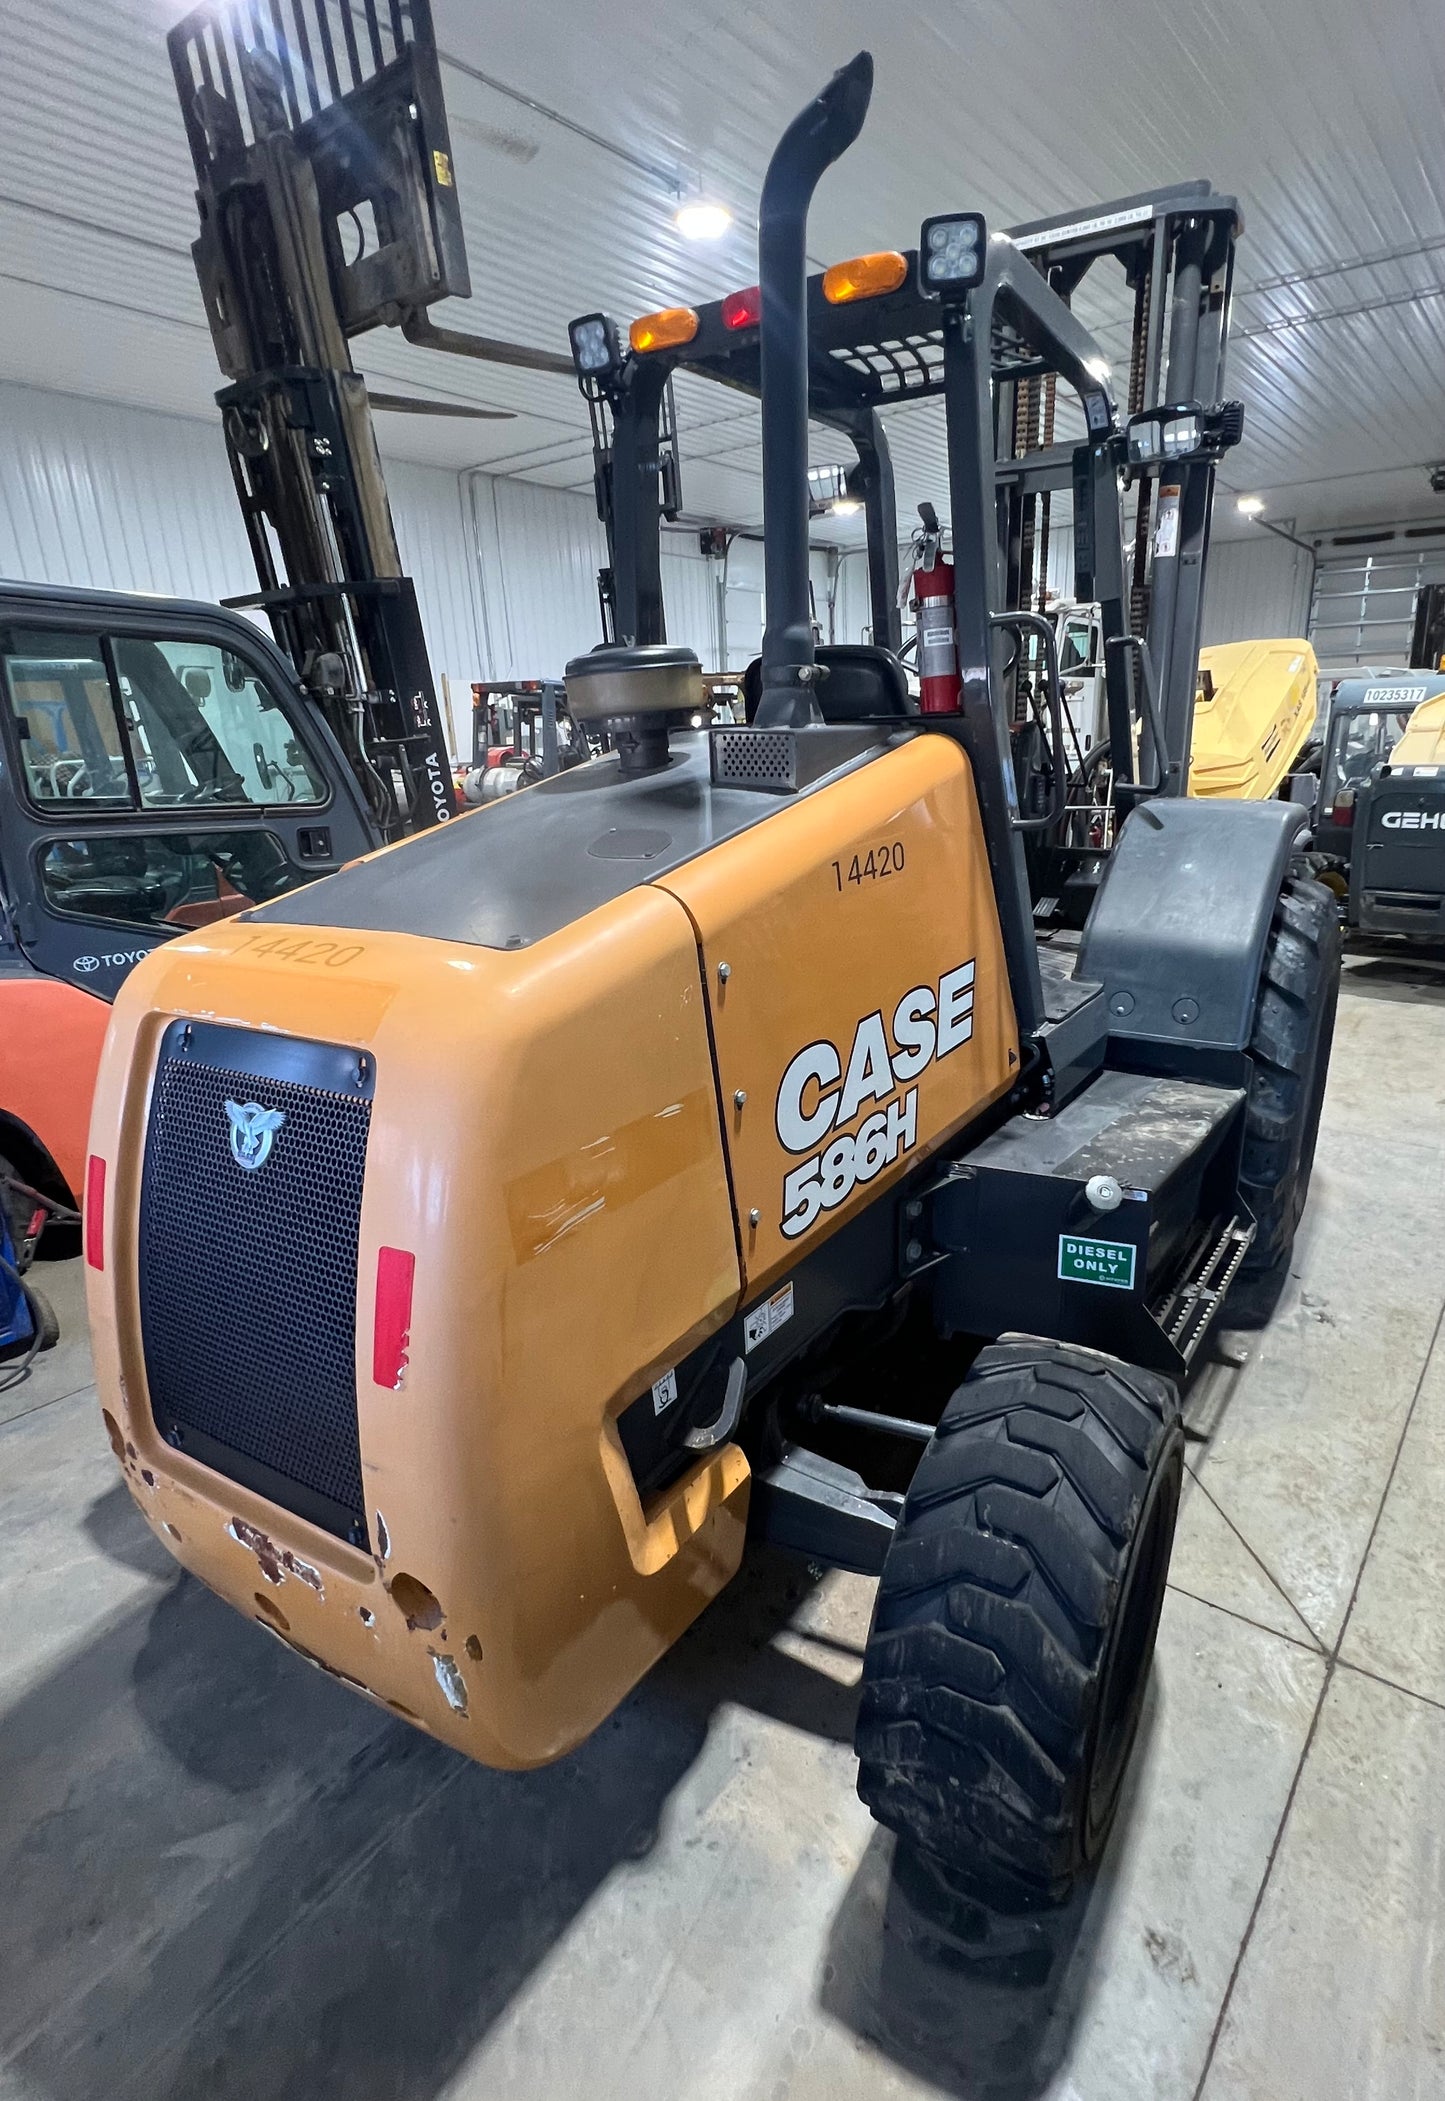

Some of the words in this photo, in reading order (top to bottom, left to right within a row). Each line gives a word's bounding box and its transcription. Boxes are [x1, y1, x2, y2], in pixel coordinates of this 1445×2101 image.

[1366, 688, 1424, 701] 10235317
[831, 841, 905, 892] 14420
[101, 948, 156, 967] TOYO
[230, 935, 365, 967] 14420
[775, 957, 976, 1154] CASE
[779, 1084, 919, 1240] 586H
[1066, 1243, 1128, 1262] DIESEL
[1073, 1258, 1119, 1274] ONLY
